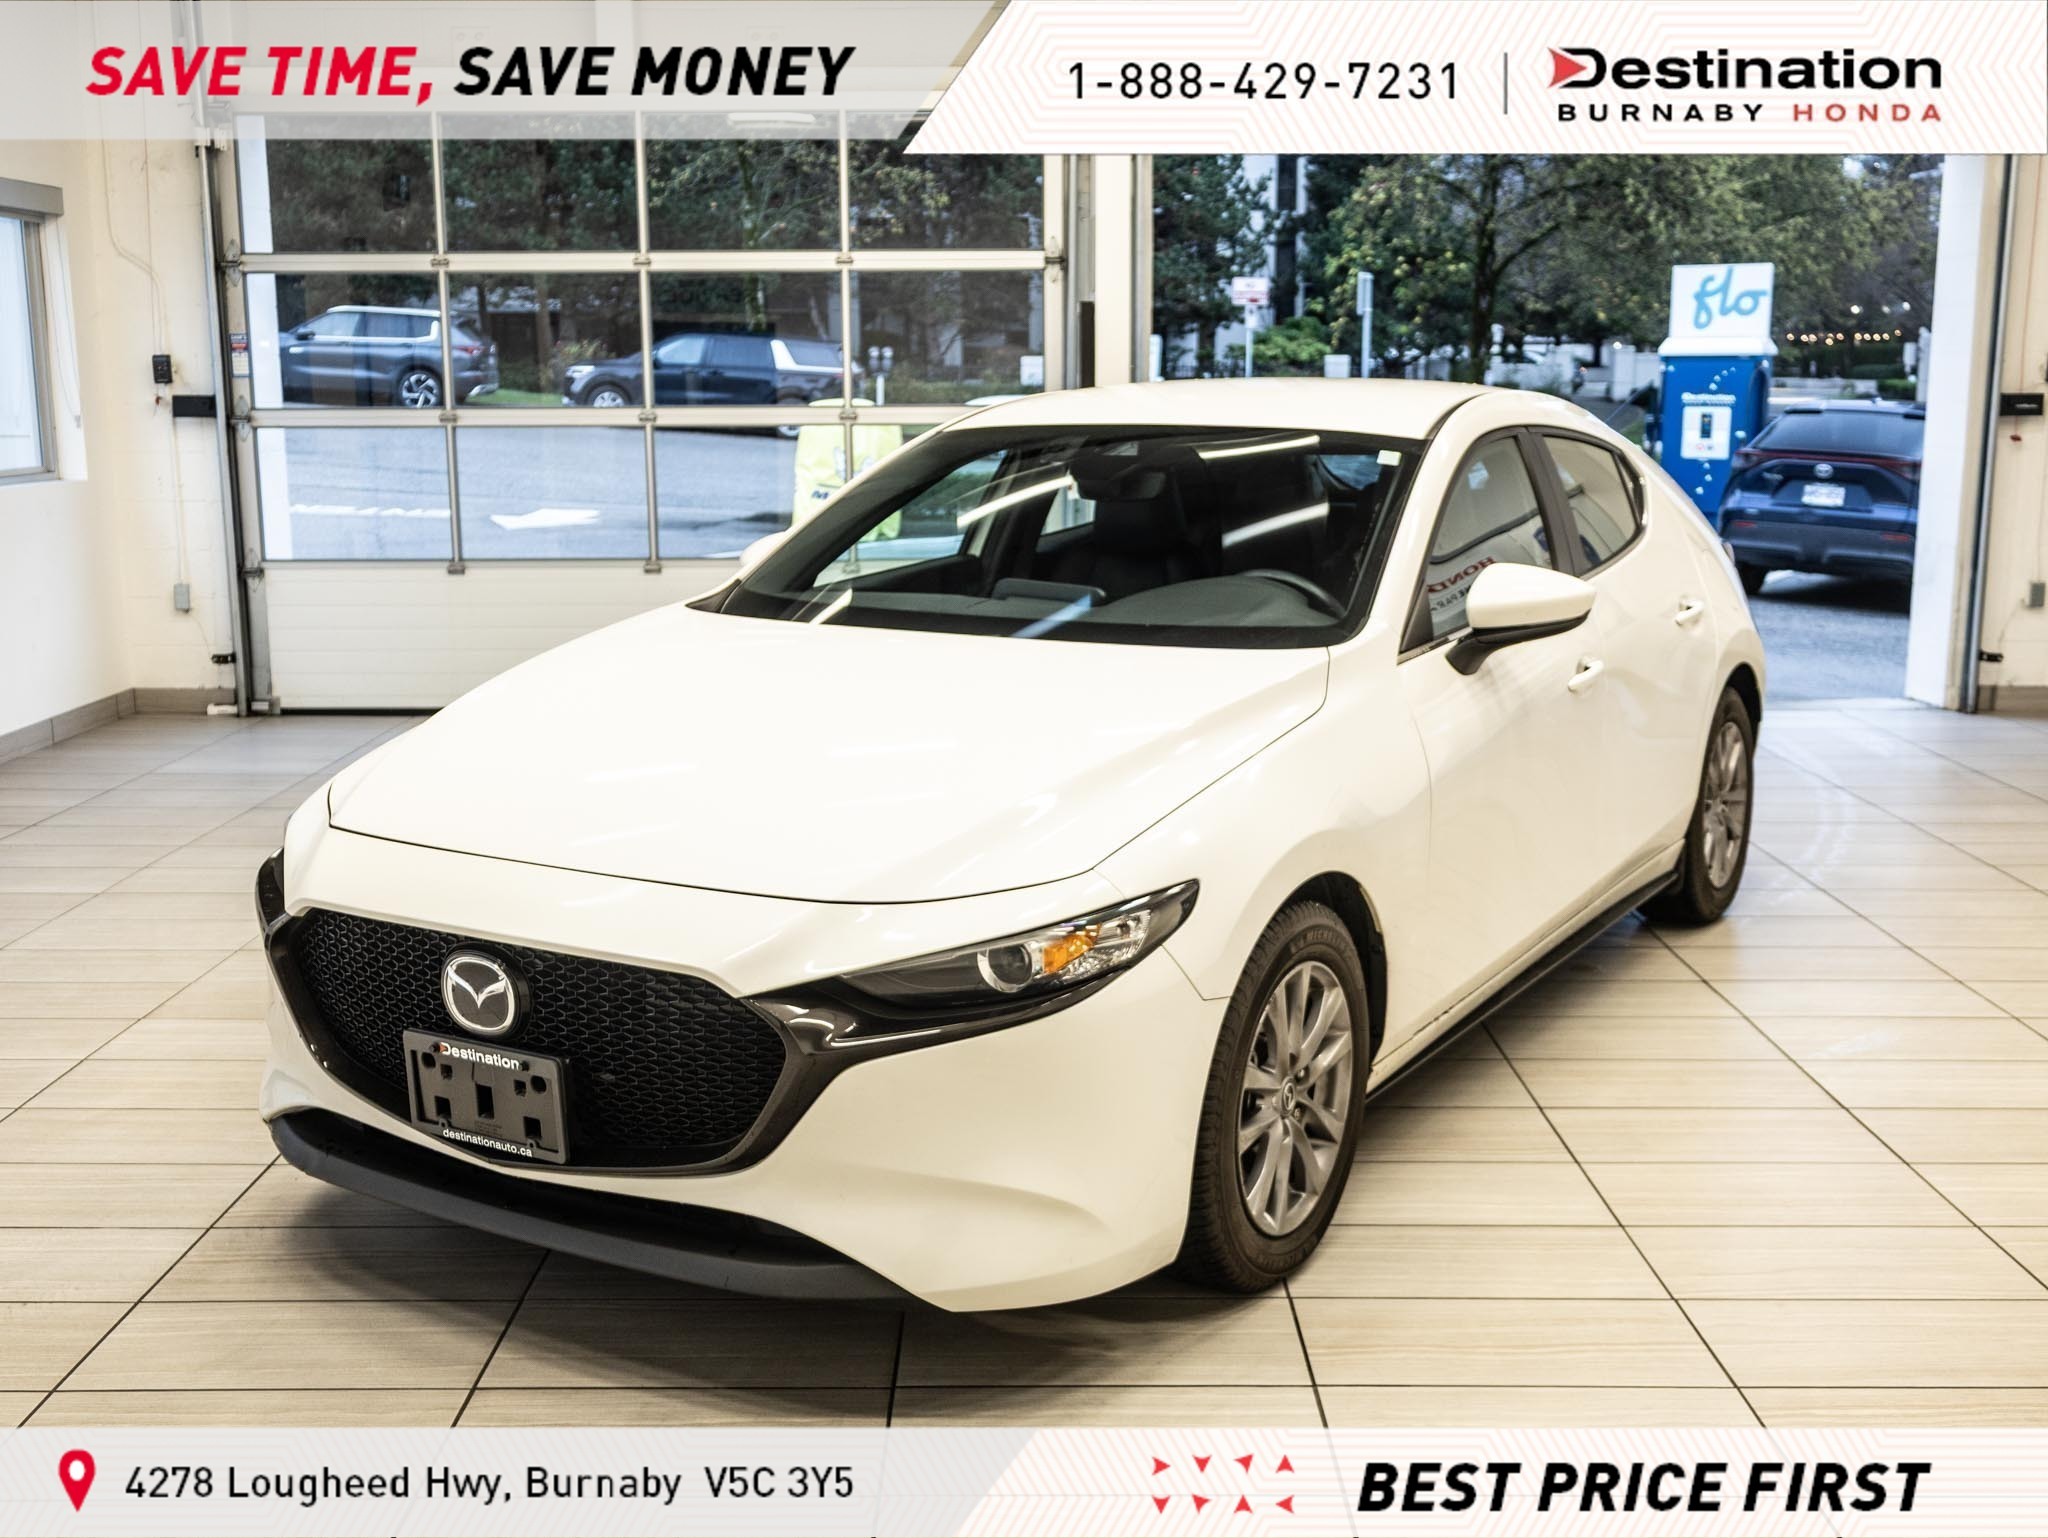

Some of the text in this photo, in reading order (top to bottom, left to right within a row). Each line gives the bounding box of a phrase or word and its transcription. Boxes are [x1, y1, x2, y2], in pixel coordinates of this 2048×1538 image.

[1693, 265, 1768, 330] flo
[440, 1041, 520, 1071] Destination
[442, 1128, 533, 1158] destinationauto.ca
